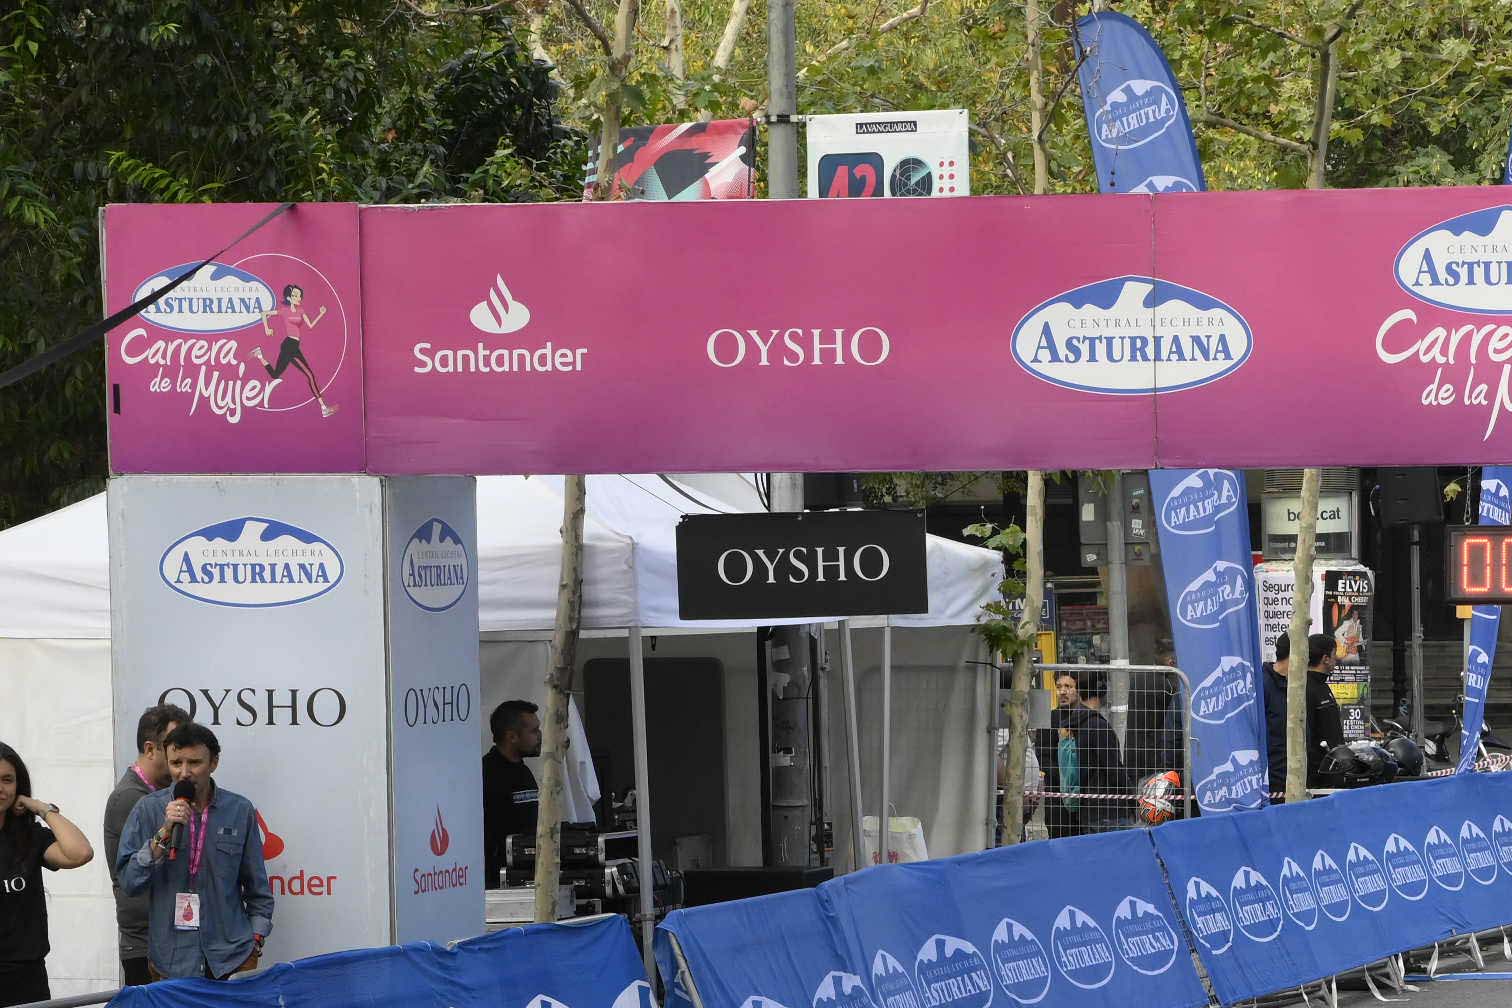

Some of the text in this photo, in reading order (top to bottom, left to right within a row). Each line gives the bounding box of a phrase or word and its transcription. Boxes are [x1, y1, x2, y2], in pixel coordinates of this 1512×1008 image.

[867, 121, 916, 133] VANGUARDIA
[1067, 316, 1226, 329] CENTRAL LECHERA
[121, 329, 239, 365] Carrera
[414, 342, 587, 373] Santander
[706, 327, 890, 367] OYSHO
[1030, 320, 1234, 364] ASTURIANA
[150, 362, 283, 423] de la Mujer
[1421, 368, 1455, 406] de
[1464, 368, 1488, 406] la
[1287, 507, 1341, 522] b.cat
[1479, 501, 1511, 524] STURIAN
[174, 551, 330, 584] ASTURIANA
[203, 548, 324, 559] CENTRAL LECHERA
[717, 544, 890, 585] OYSHO
[407, 553, 464, 589] ASTURIANA
[1338, 579, 1368, 592] ELVIS
[1264, 597, 1279, 608] que
[1264, 607, 1295, 620] quiere
[1265, 622, 1289, 633] mete
[1265, 635, 1277, 646] est
[158, 687, 346, 727] OYSHO
[404, 684, 471, 728] OYSHO
[1349, 708, 1361, 719] 30
[413, 863, 469, 895] Santander
[997, 952, 1048, 986] ASTURIANA
[1058, 940, 1112, 973] ASTURIANA
[921, 969, 991, 1008] ASTURIANA
